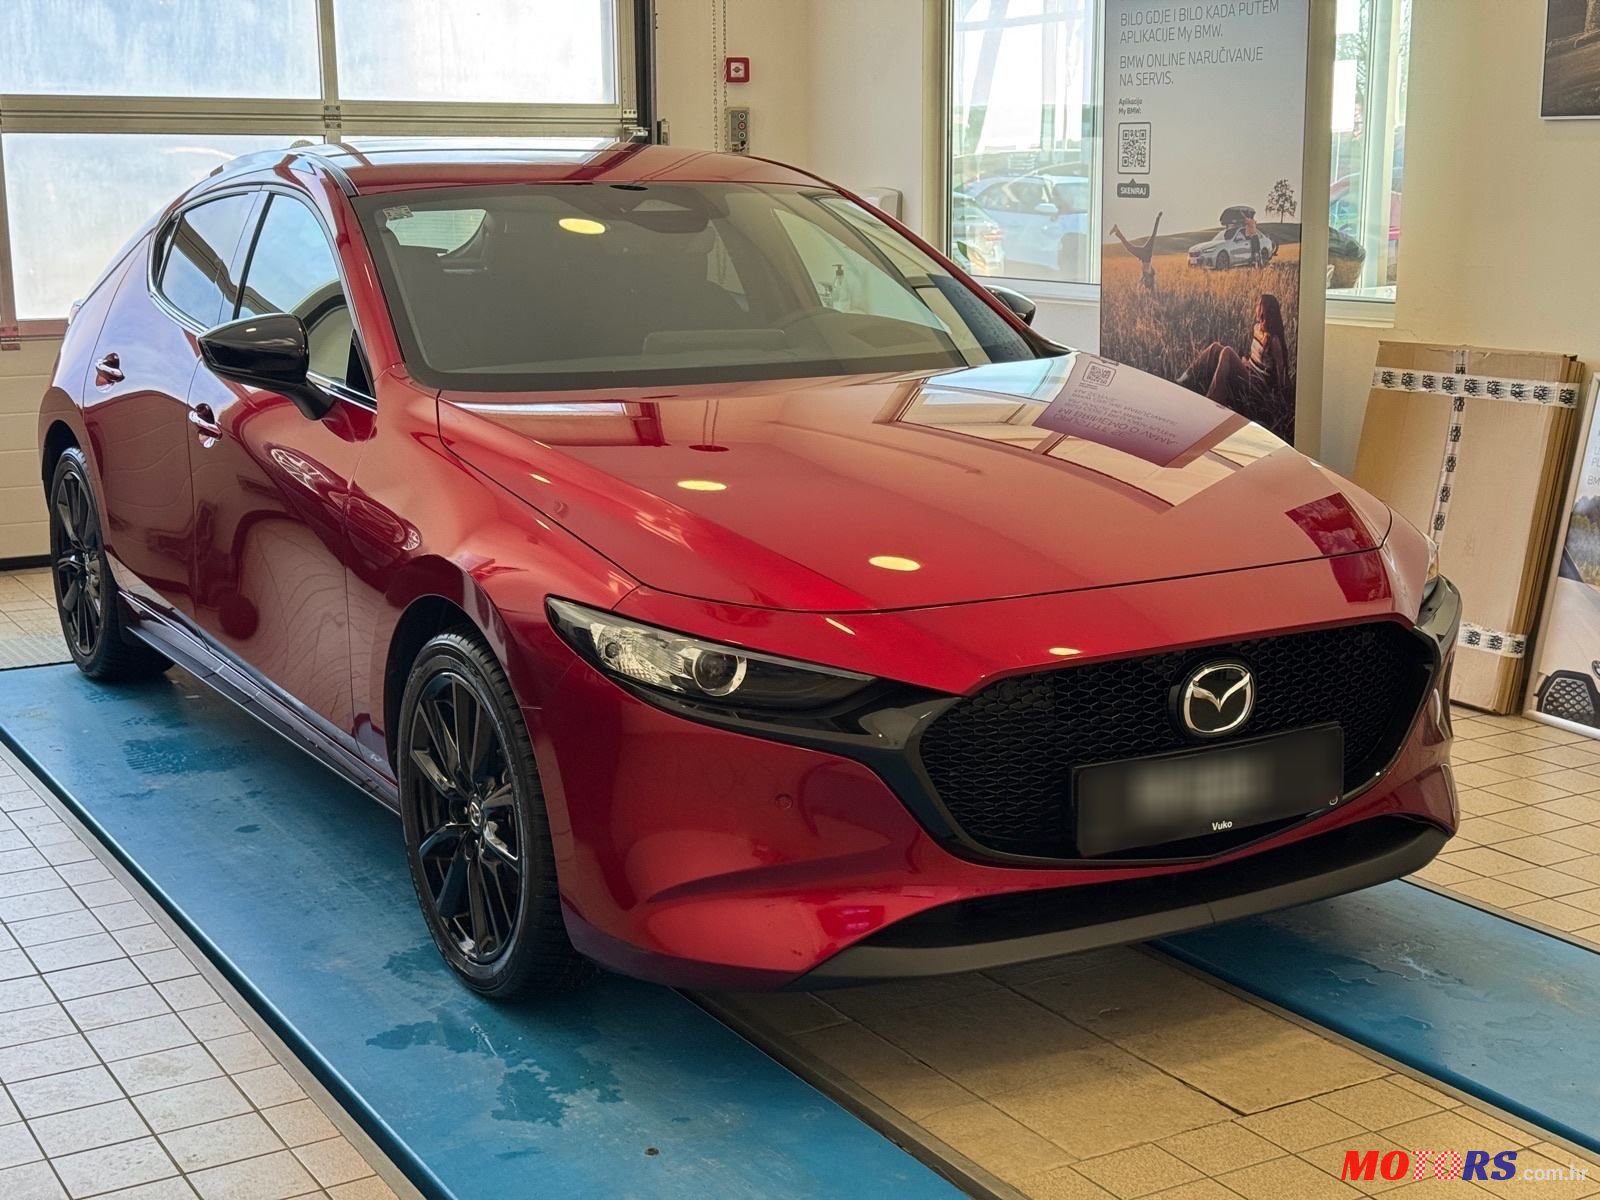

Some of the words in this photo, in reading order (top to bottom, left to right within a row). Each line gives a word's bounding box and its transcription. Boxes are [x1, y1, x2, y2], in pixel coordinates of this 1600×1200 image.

[1121, 11, 1143, 26] BILO
[1146, 9, 1171, 24] GDJE
[1179, 6, 1203, 21] BILO
[1206, 3, 1236, 19] KADA
[1239, 0, 1279, 16] PUTEM
[1120, 27, 1175, 44] APLIKACIJE
[1178, 26, 1192, 42] My
[1195, 24, 1223, 39] BMW.
[1120, 54, 1145, 69] BMW
[1147, 51, 1185, 67] ONLINE
[1188, 46, 1264, 65] NARUČIVANJE
[1120, 73, 1134, 87] NA
[1136, 70, 1174, 86] SERVIS.
[1212, 821, 1233, 831] Vuko
